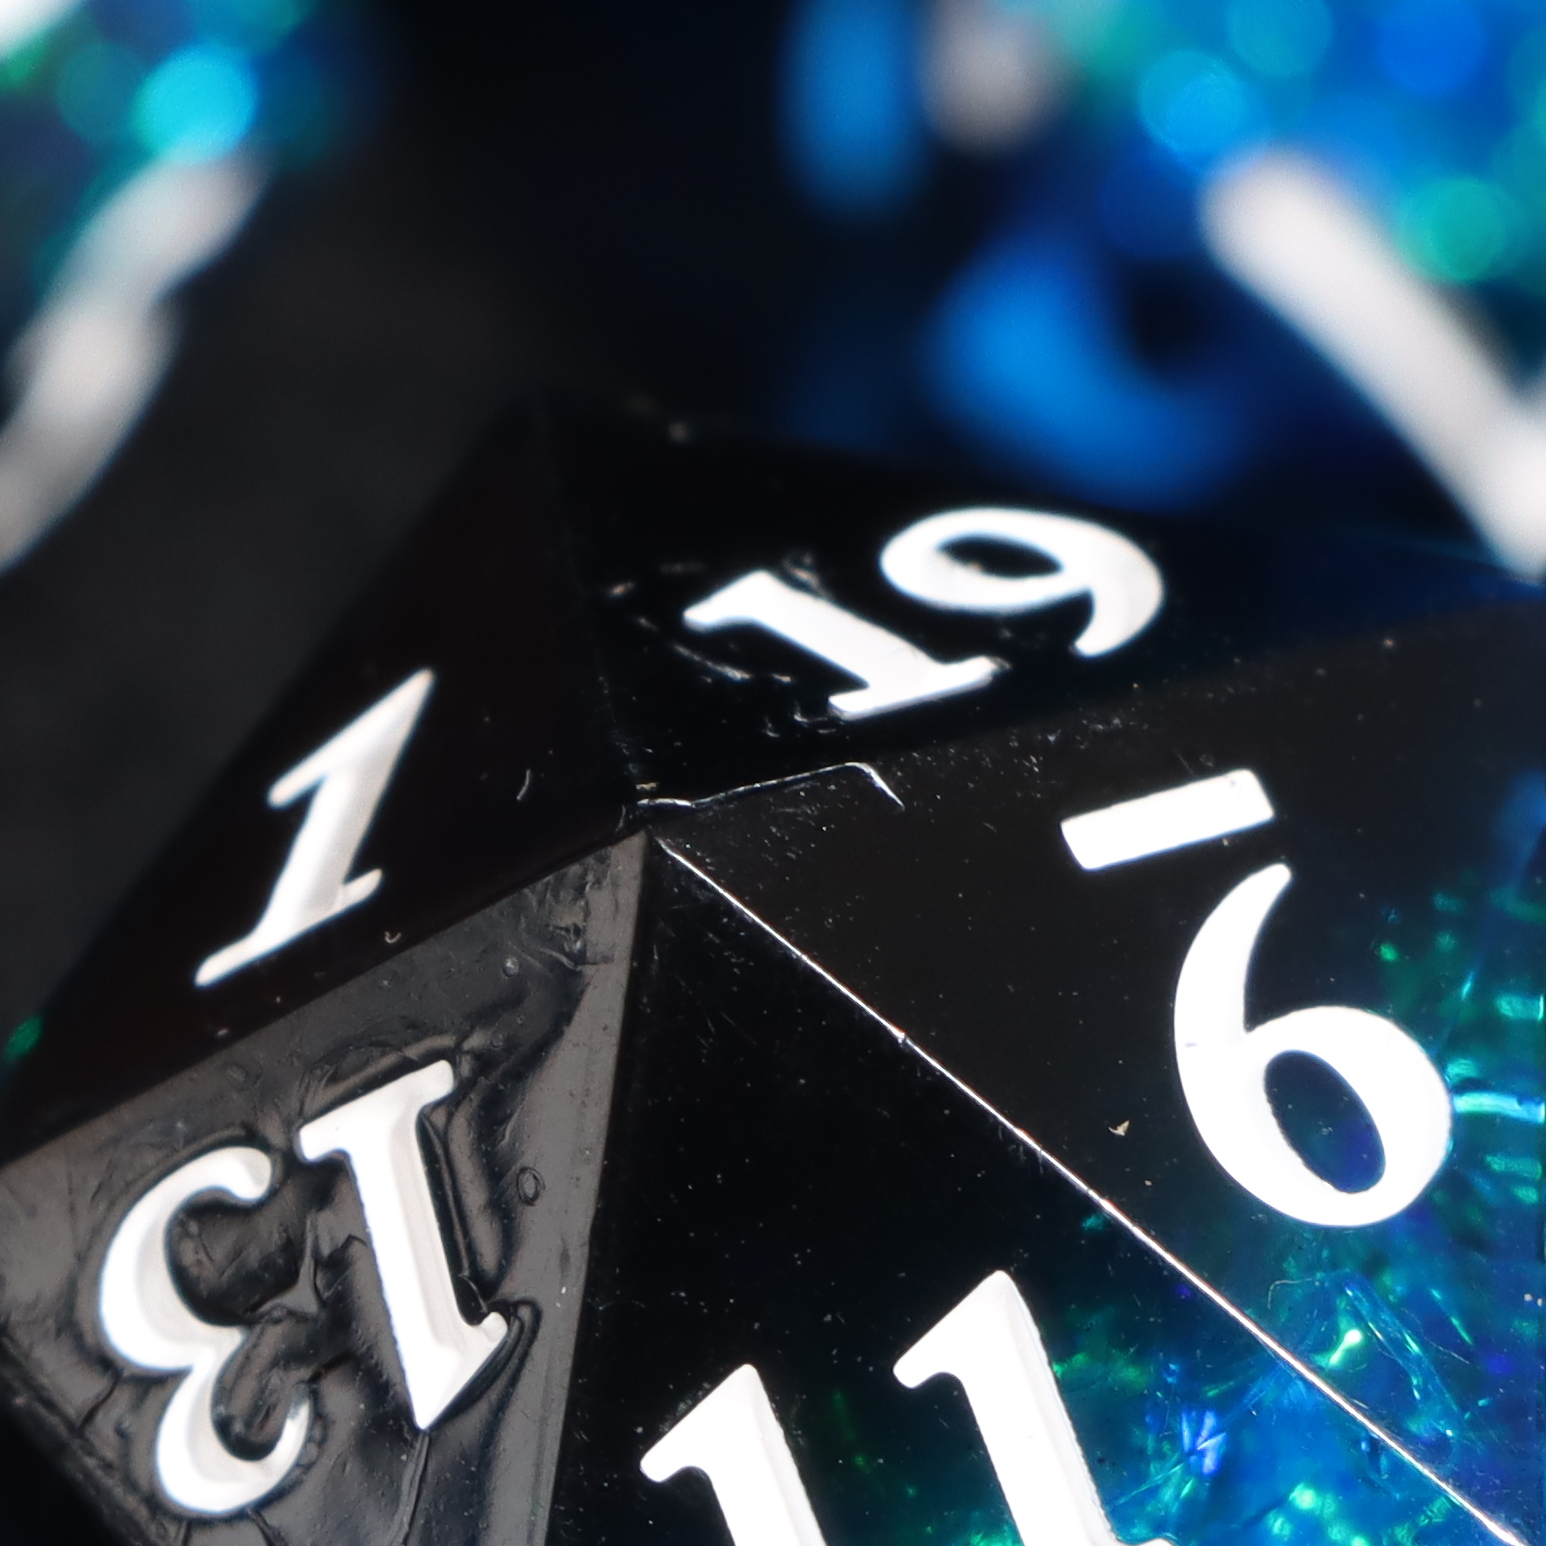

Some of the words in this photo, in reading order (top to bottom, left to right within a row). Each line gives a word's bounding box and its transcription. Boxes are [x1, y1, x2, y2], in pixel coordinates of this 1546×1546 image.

[681, 505, 1165, 721] 19
[194, 667, 435, 987] 1
[96, 1058, 509, 1519] 13
